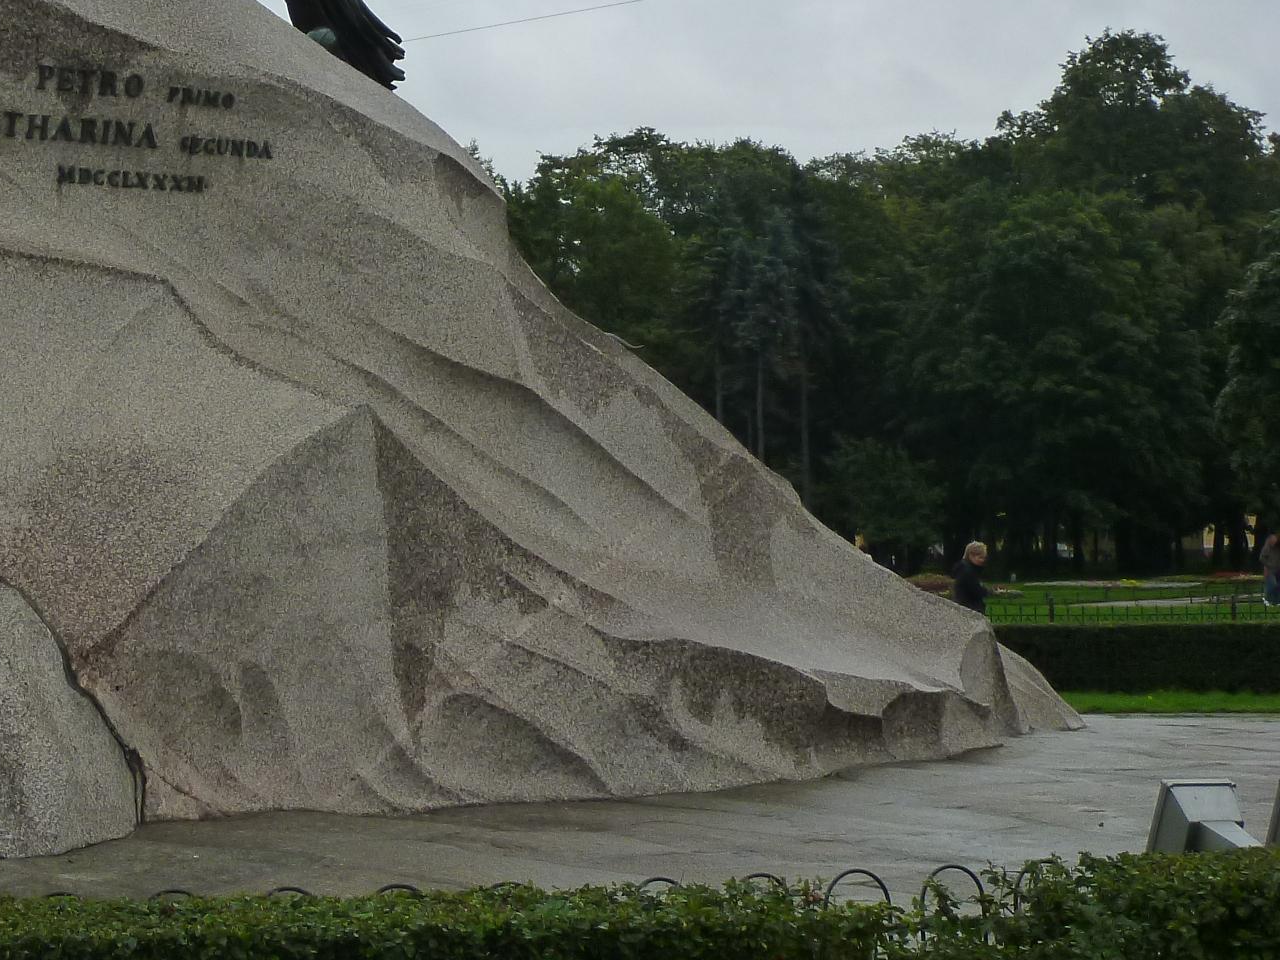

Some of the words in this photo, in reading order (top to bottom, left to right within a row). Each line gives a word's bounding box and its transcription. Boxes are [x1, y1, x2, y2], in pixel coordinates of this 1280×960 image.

[37, 64, 144, 98] PETRO
[166, 86, 236, 109] PRIMO
[179, 136, 273, 159] SECUNDA
